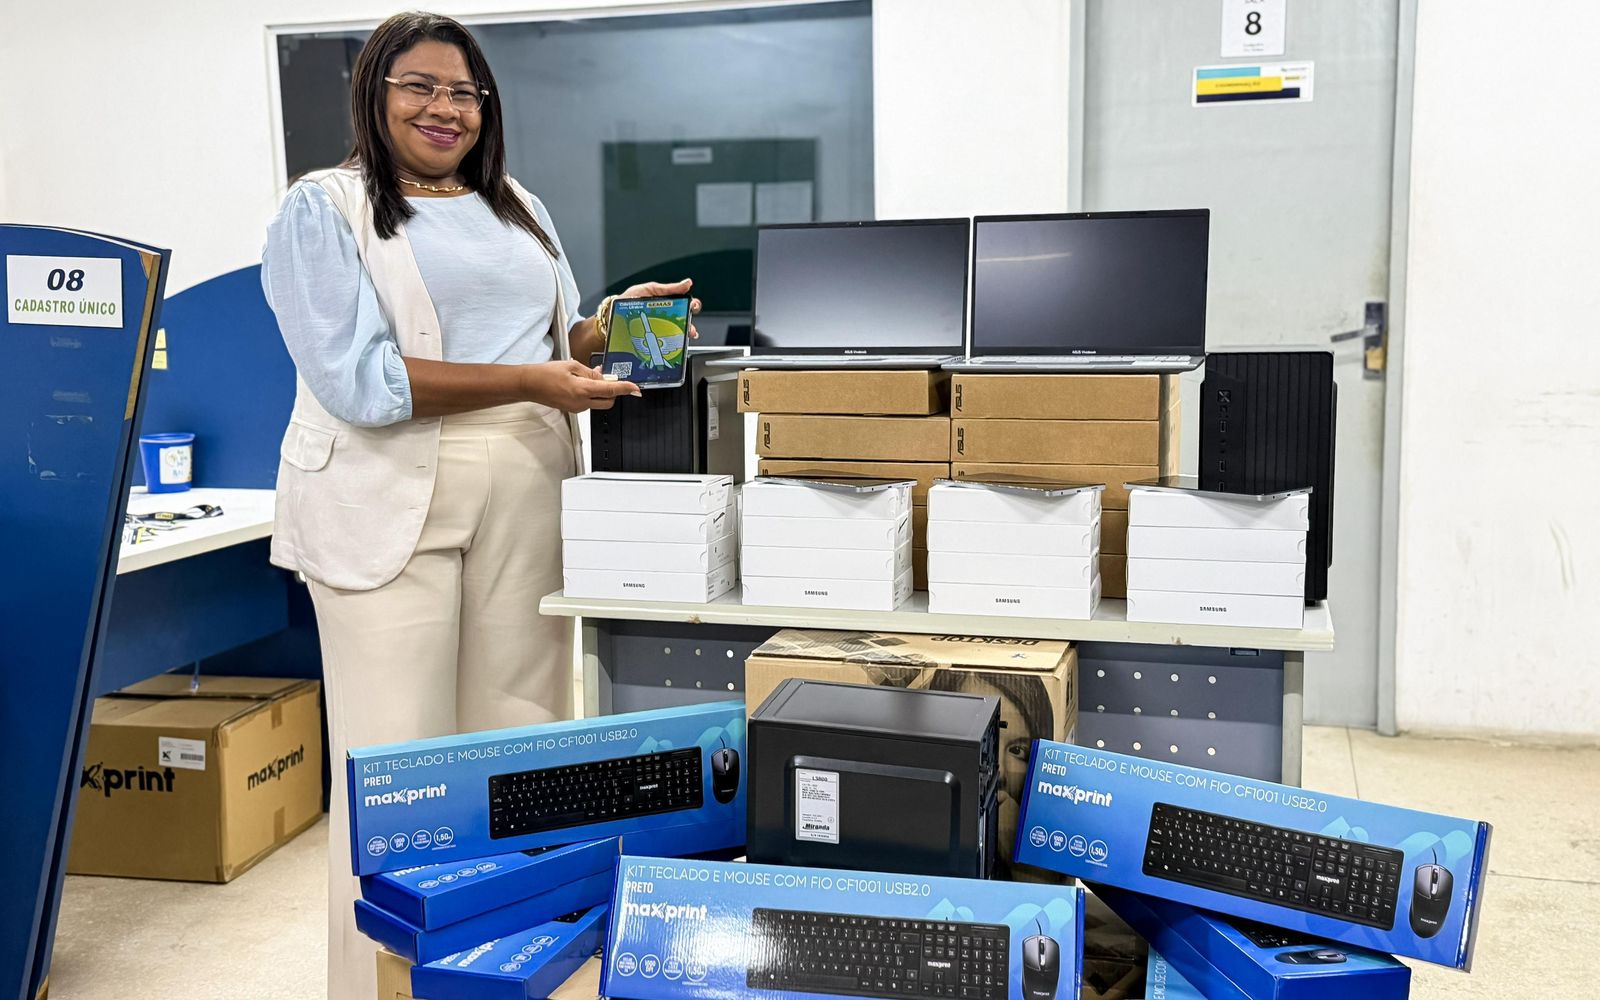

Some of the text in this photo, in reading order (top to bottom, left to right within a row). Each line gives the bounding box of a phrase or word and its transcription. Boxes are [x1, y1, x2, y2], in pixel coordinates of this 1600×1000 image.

[1245, 11, 1262, 35] 8
[47, 268, 85, 291] 08
[14, 298, 116, 315] CADASTRO ÚNICO
[932, 635, 1040, 645] DESKTOP
[363, 728, 638, 774] KIT TECLADO E MOUSE COM FIO CF1001 USB2.0
[248, 743, 304, 790] maxprint
[1042, 762, 1067, 776] PRETO
[80, 762, 175, 797] xprint
[364, 775, 391, 788] PRETO
[1044, 748, 1328, 813] KIT TECLADO E MOUSE COM FIO CF1001 USB2.0
[364, 783, 447, 807] maxprint
[1038, 781, 1113, 807] maxprint
[626, 881, 654, 894] PRETO
[627, 865, 931, 897] KIT TECLADO E MOUSE COM FIO CF1001 USB2.0
[1316, 875, 1340, 884] maxprint
[624, 901, 708, 923] maxprint
